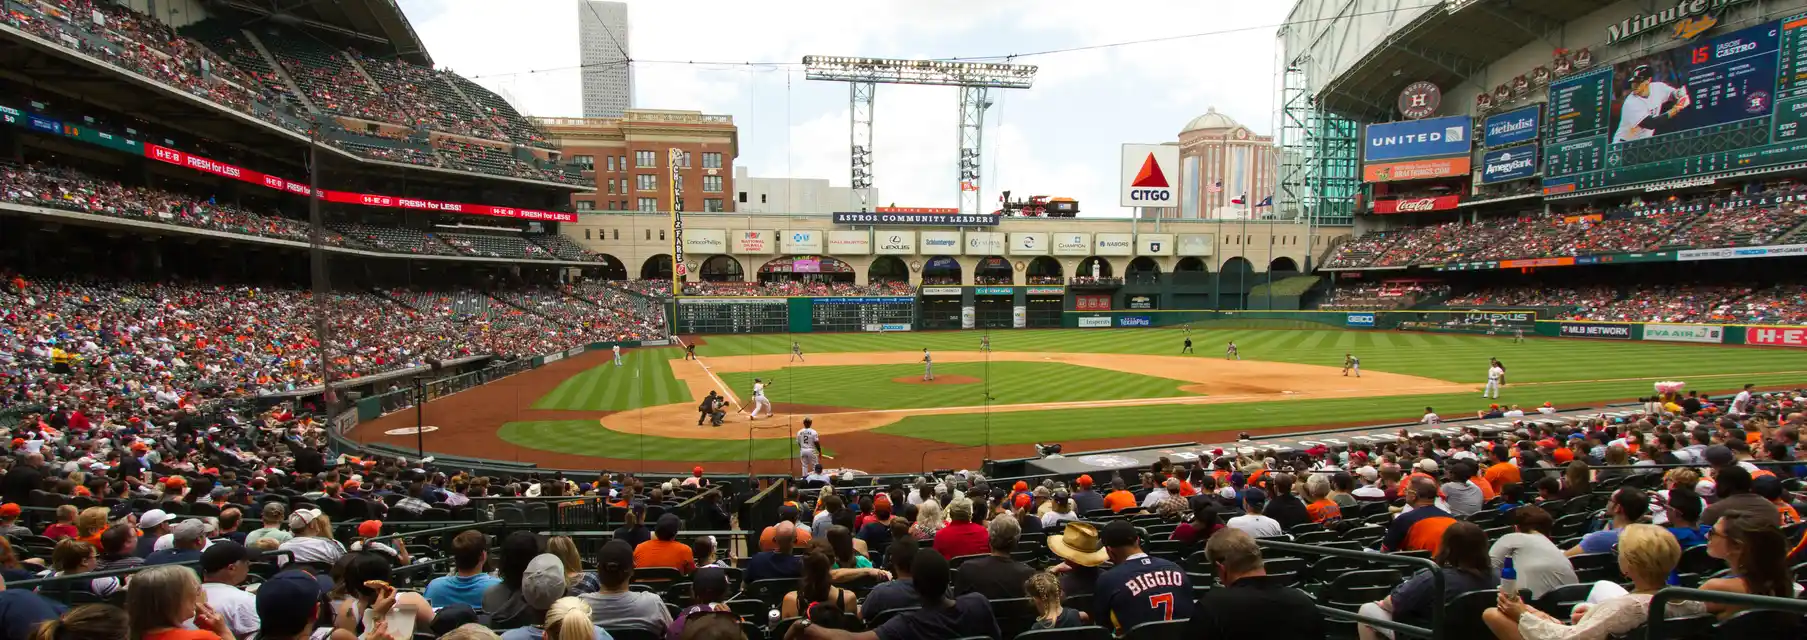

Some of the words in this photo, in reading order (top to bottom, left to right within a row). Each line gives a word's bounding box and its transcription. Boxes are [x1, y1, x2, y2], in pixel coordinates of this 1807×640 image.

[1606, 0, 1707, 46] Minute
[1716, 39, 1742, 52] JASON
[1716, 42, 1756, 59] CASTRO
[1691, 46, 1709, 65] 15
[1411, 93, 1426, 107] H
[4, 114, 15, 123] 50
[1488, 118, 1534, 137] Methodist
[1373, 132, 1441, 147] UNITED
[1561, 141, 1593, 152] PITCHING
[187, 156, 211, 169] FRESH
[211, 162, 221, 173] for
[222, 165, 241, 178] LESS!
[1486, 157, 1533, 175] AmegyBank
[287, 182, 303, 193] FRESH
[1645, 179, 1716, 192] DAKTRONICS
[1131, 189, 1169, 201] CITGO
[399, 199, 426, 209] FRESH
[427, 201, 439, 210] for
[440, 202, 462, 212] LESS!
[1396, 198, 1437, 212] Coca-Cola
[521, 210, 542, 219] FRESH
[543, 212, 552, 220] for
[553, 213, 571, 221] LESS!
[839, 214, 878, 222] ASTROS
[882, 215, 946, 223] COMMUNITY
[925, 239, 955, 247] Schlumberger
[1086, 318, 1111, 326] Insperity
[1120, 318, 1150, 326] TexanPlus
[1347, 315, 1373, 323] GEICO
[1483, 312, 1528, 322] LEXUS
[1569, 325, 1585, 335] MLB
[1586, 326, 1628, 336] NETWORK
[1646, 329, 1669, 337] EVA
[1671, 330, 1693, 338] AIR
[803, 435, 809, 444] 2
[1125, 570, 1183, 596] BIGGIO
[1149, 592, 1174, 621] 7
